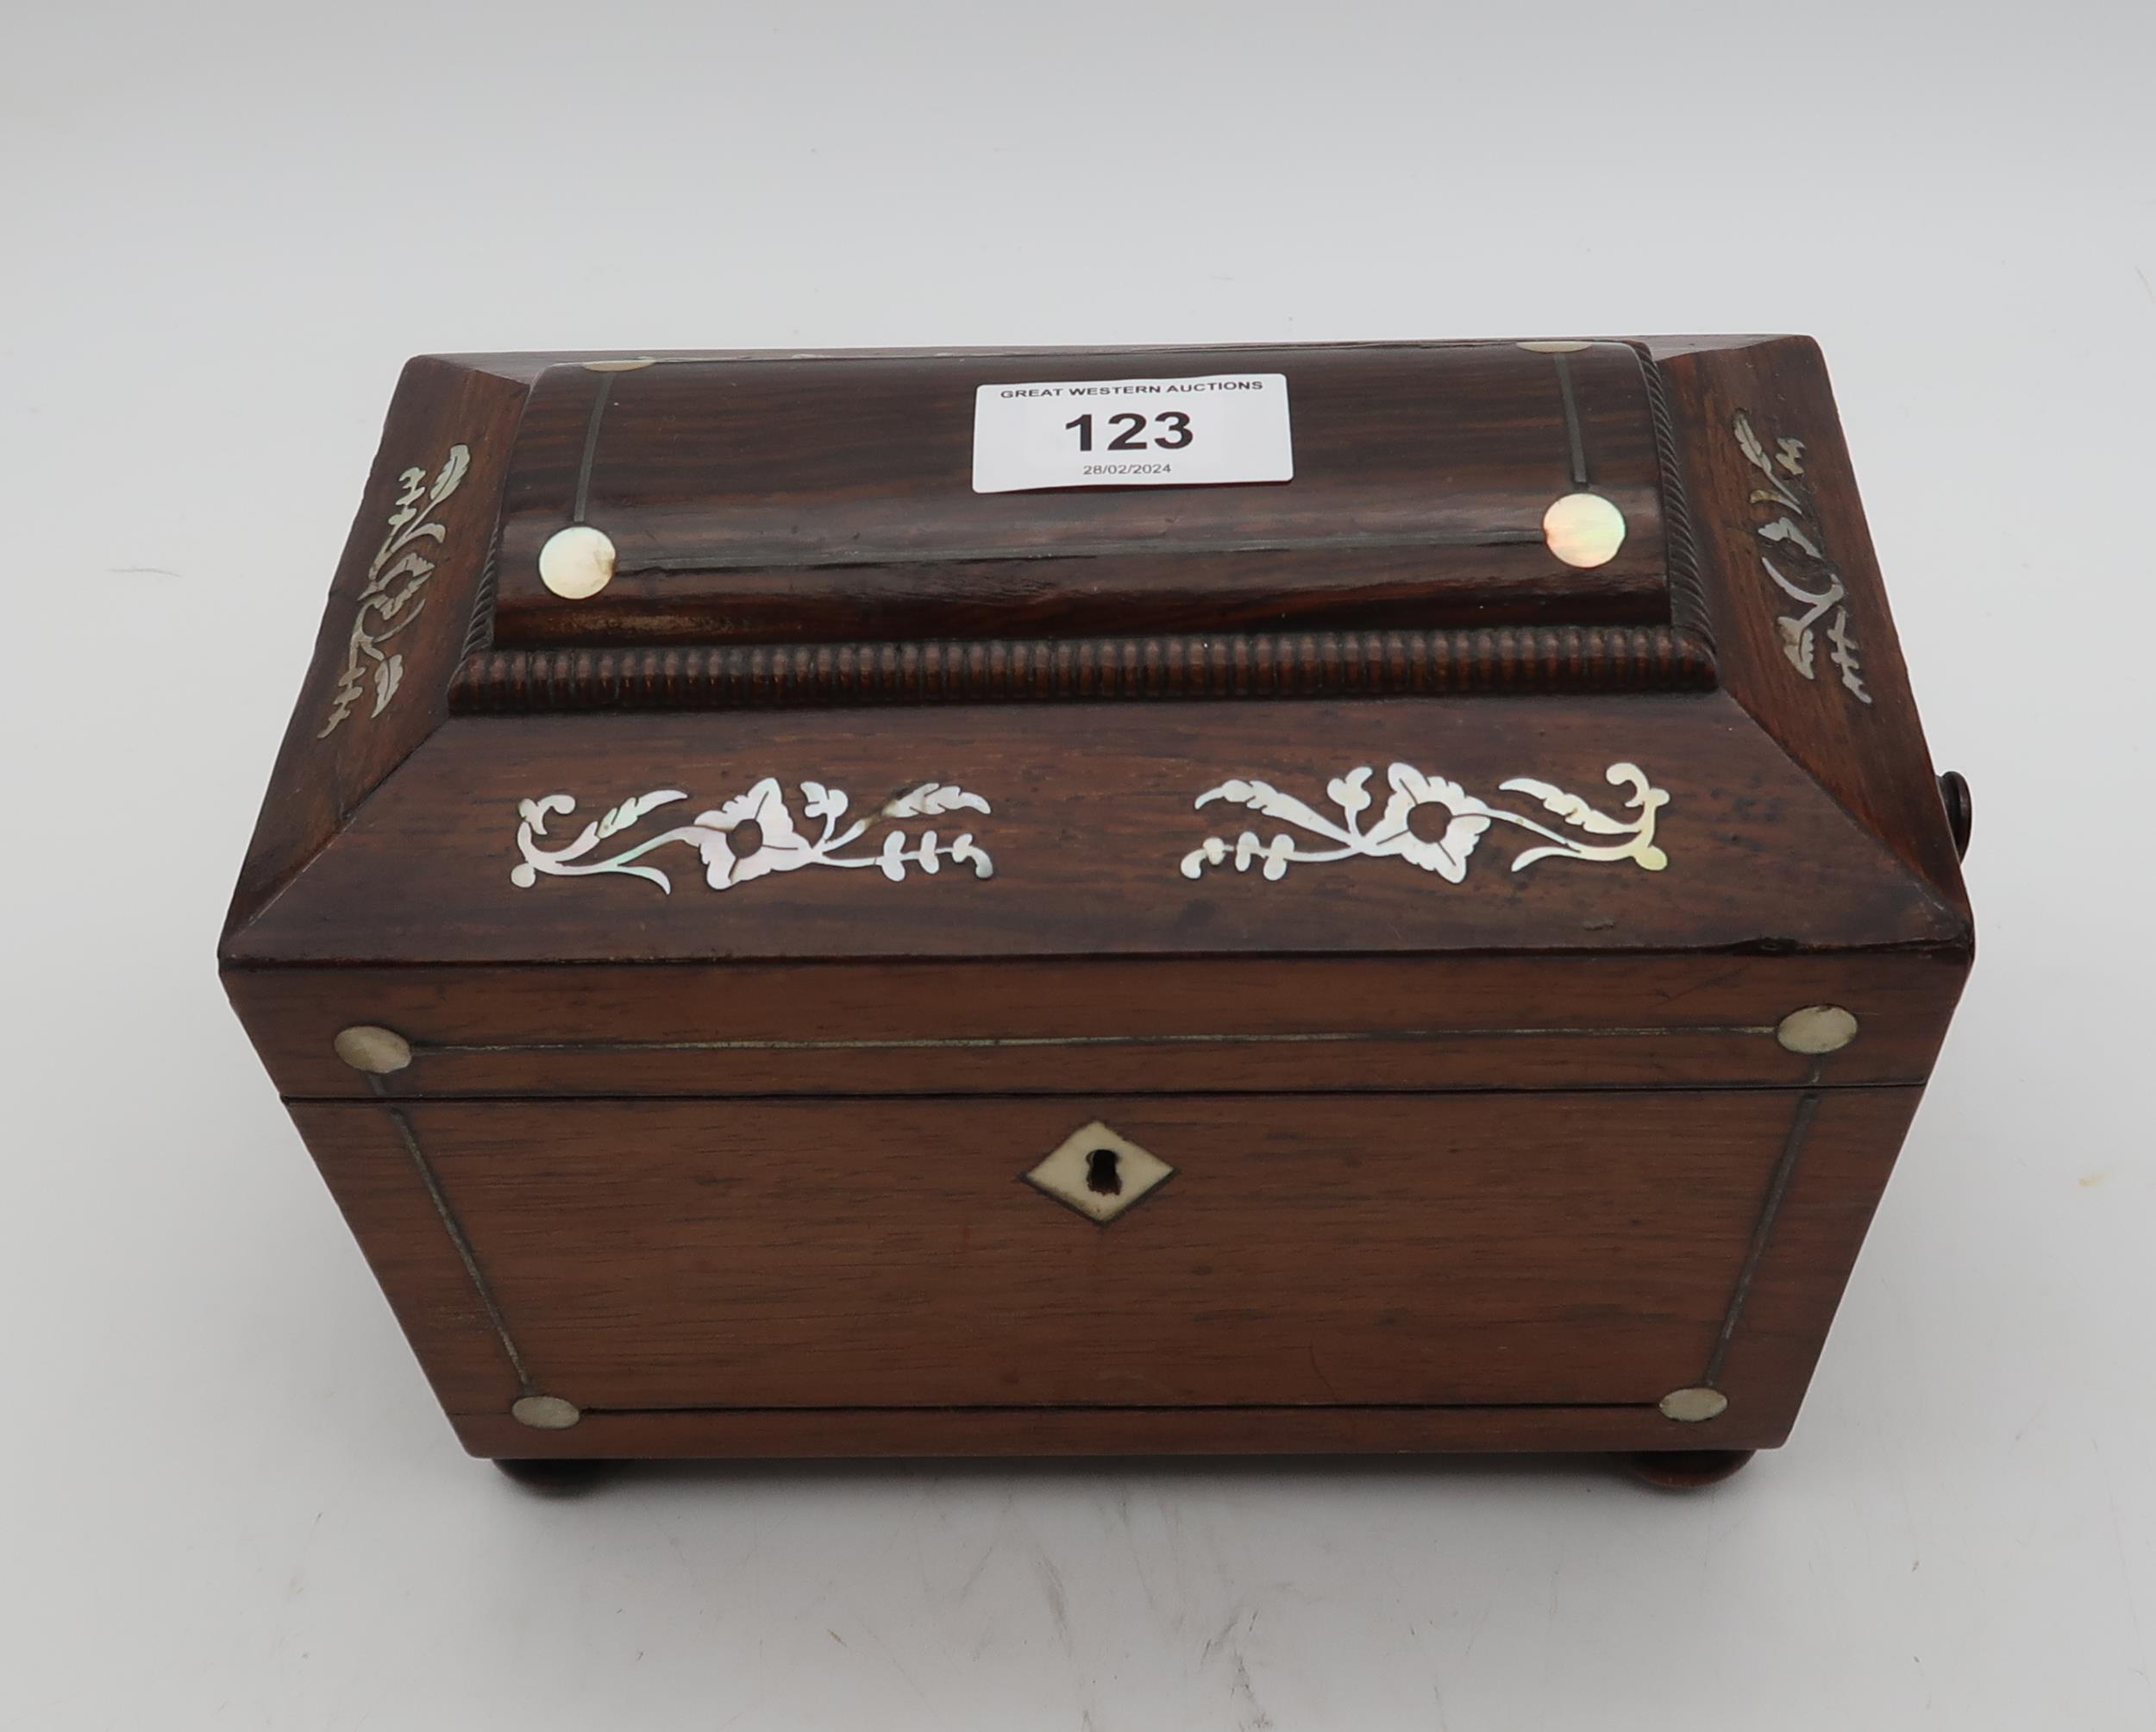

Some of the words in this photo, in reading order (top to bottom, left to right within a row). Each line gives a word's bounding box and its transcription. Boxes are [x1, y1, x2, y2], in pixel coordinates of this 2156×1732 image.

[1000, 388, 1063, 398] GREAT
[1069, 385, 1161, 396] WESTERN
[1166, 380, 1263, 392] AUCTIONS
[1065, 411, 1194, 452] 123
[1082, 463, 1172, 475] 28/02/2024
